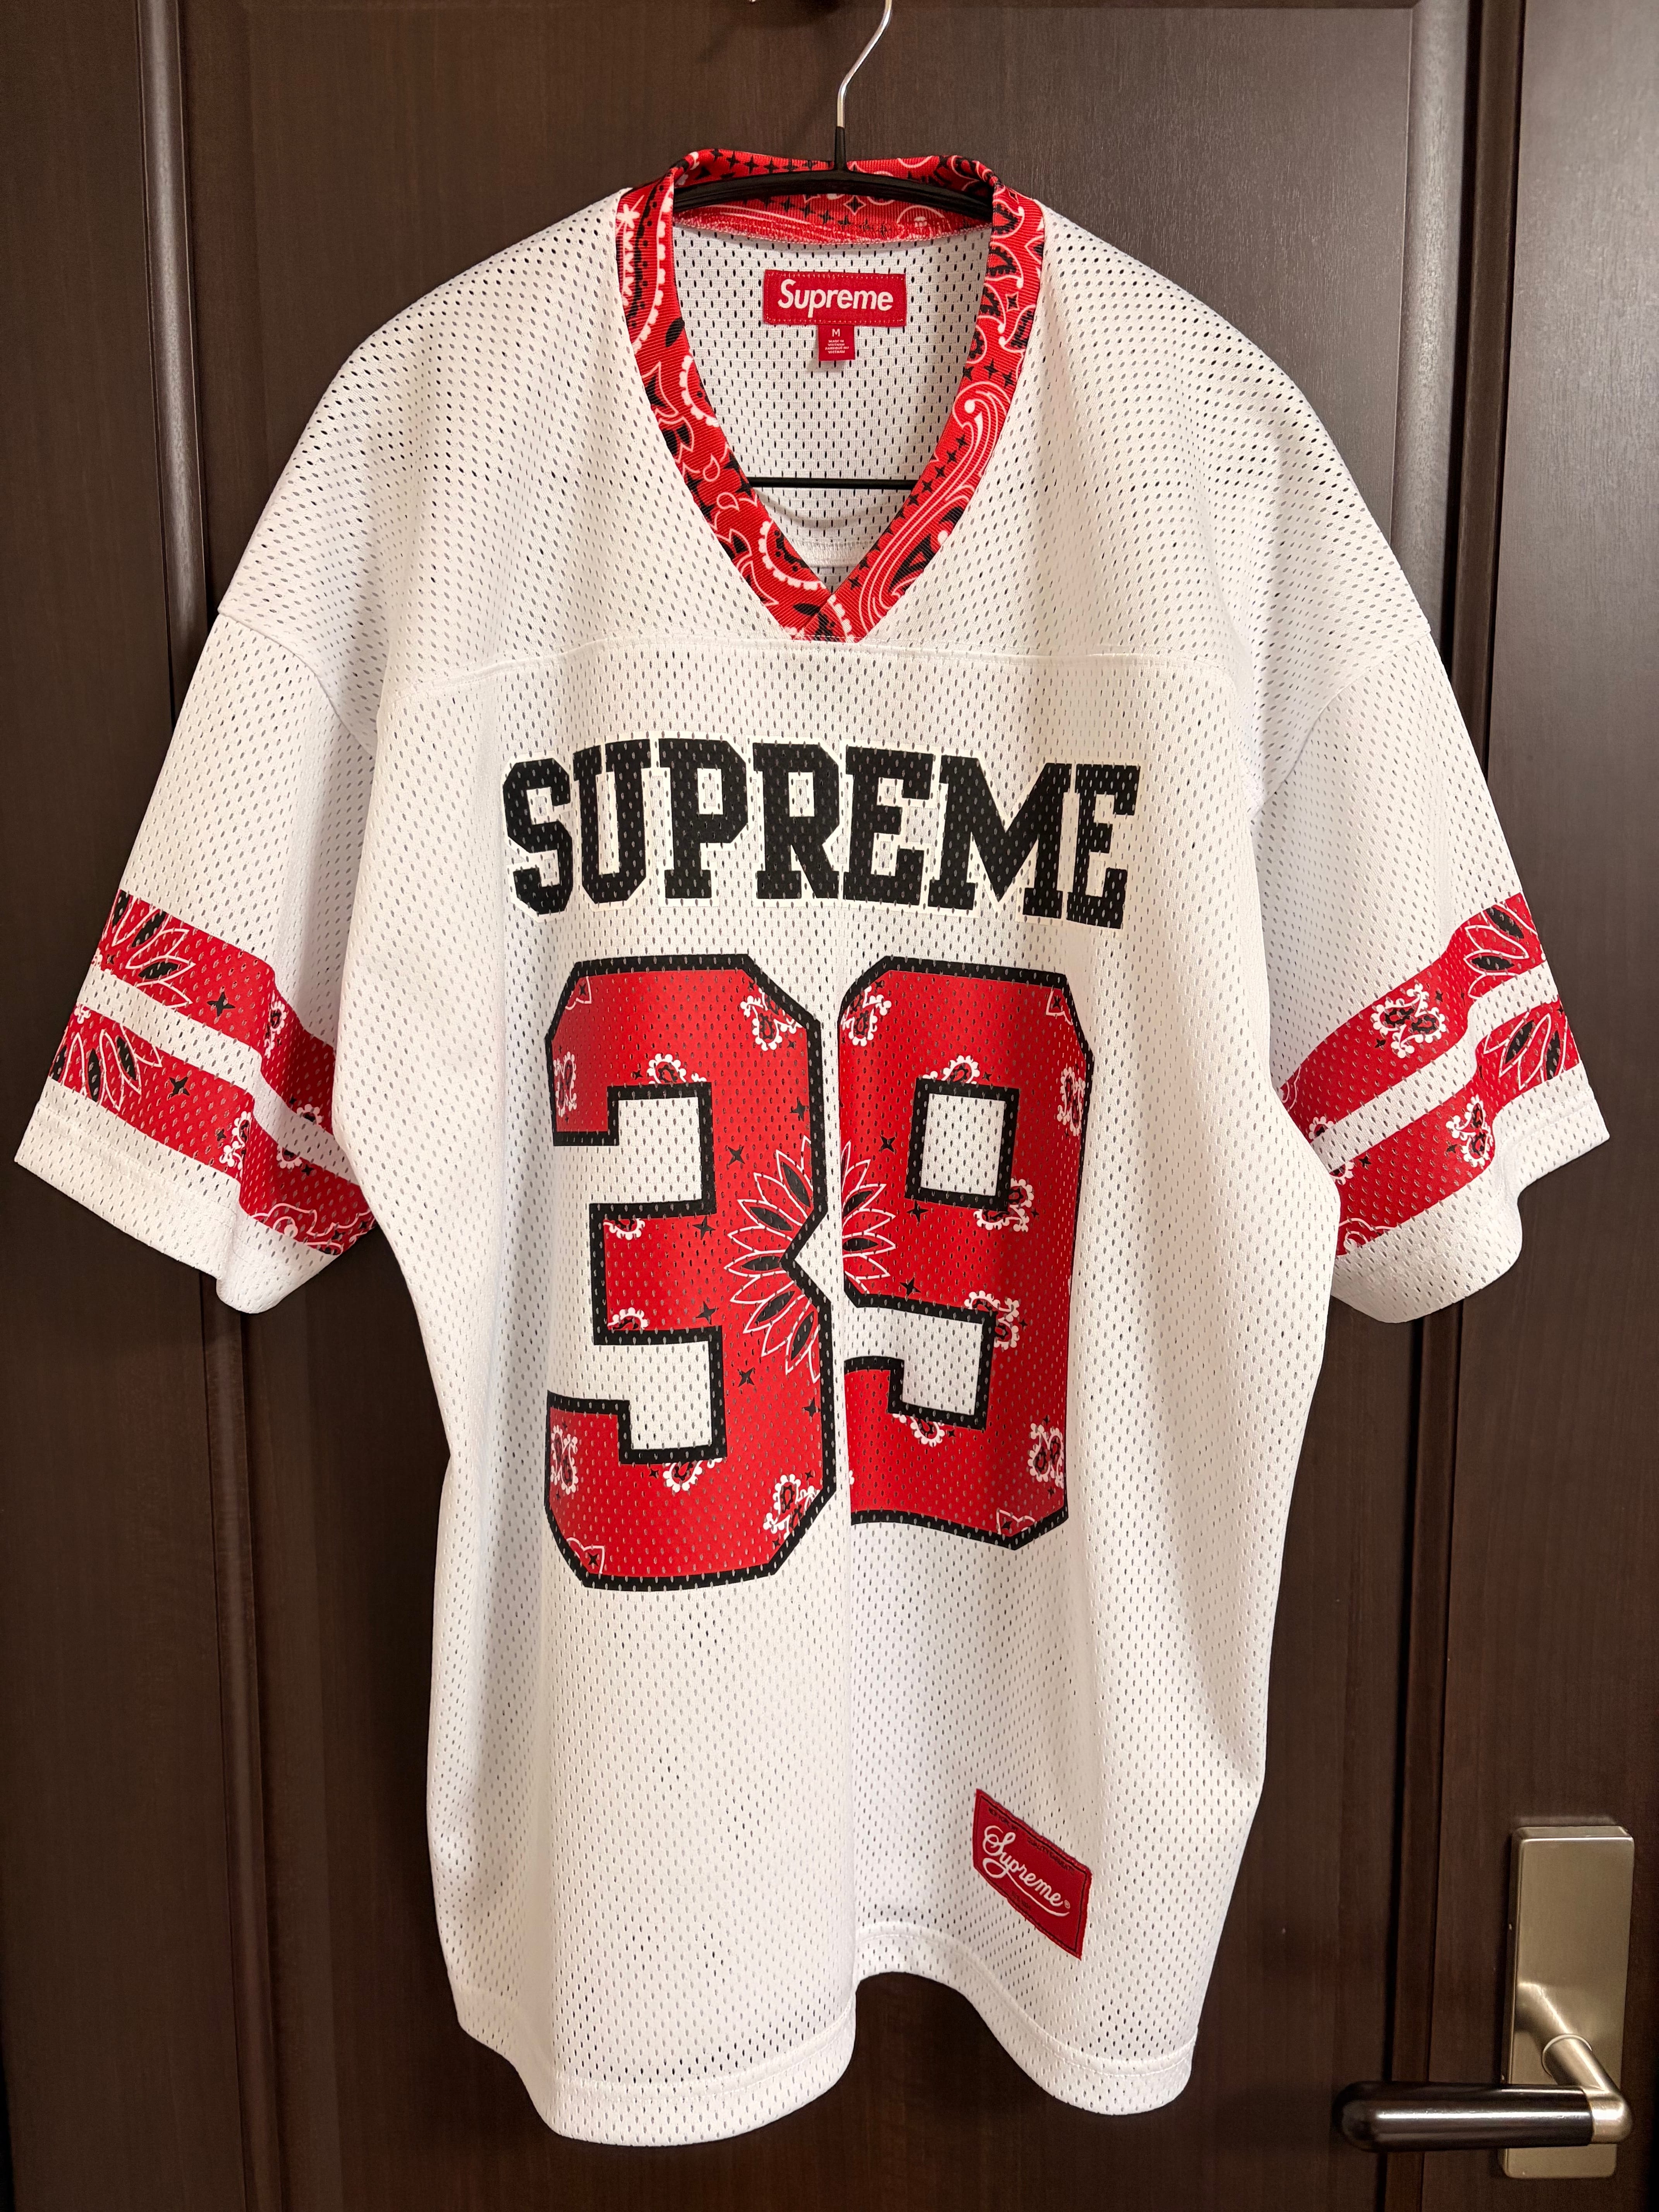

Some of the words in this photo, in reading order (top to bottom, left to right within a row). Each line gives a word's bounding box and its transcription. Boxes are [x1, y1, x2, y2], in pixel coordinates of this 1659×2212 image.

[778, 279, 894, 318] Supreme
[832, 328, 840, 337] M
[503, 738, 1141, 930] SUPREME
[544, 954, 1094, 1592] 39
